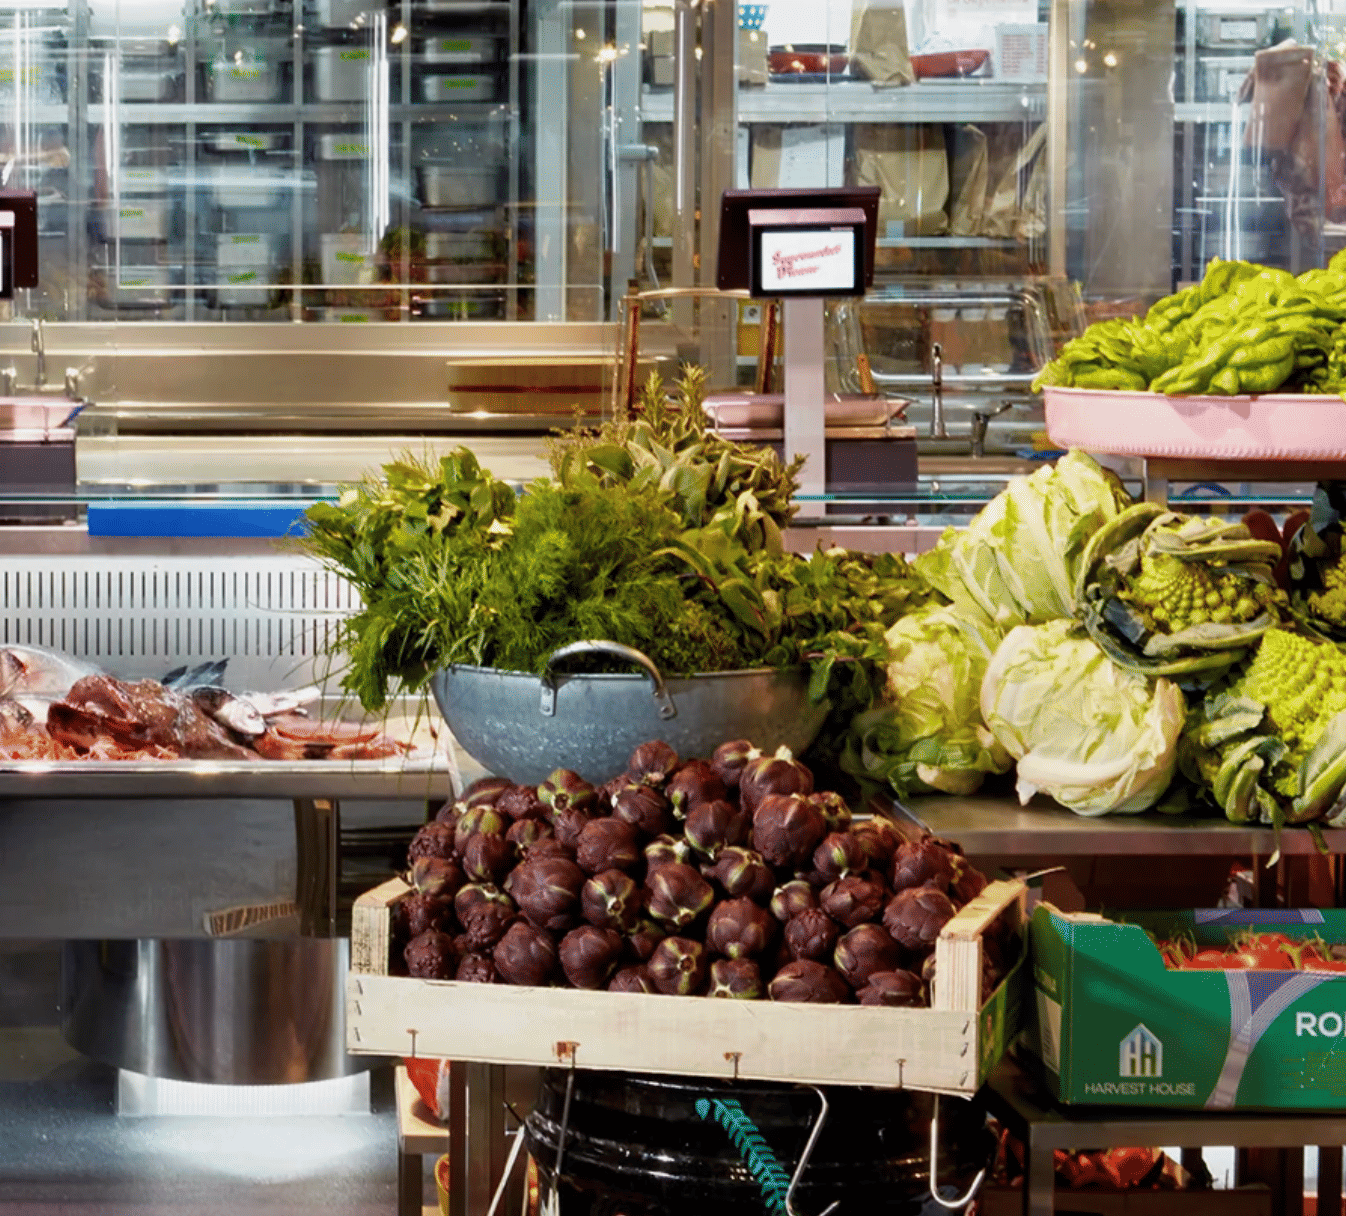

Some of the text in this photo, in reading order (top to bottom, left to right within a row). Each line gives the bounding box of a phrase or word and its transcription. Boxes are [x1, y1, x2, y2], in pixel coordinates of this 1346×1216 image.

[1295, 1011, 1346, 1037] RO
[1084, 1082, 1195, 1096] HARVEST HOUSE
